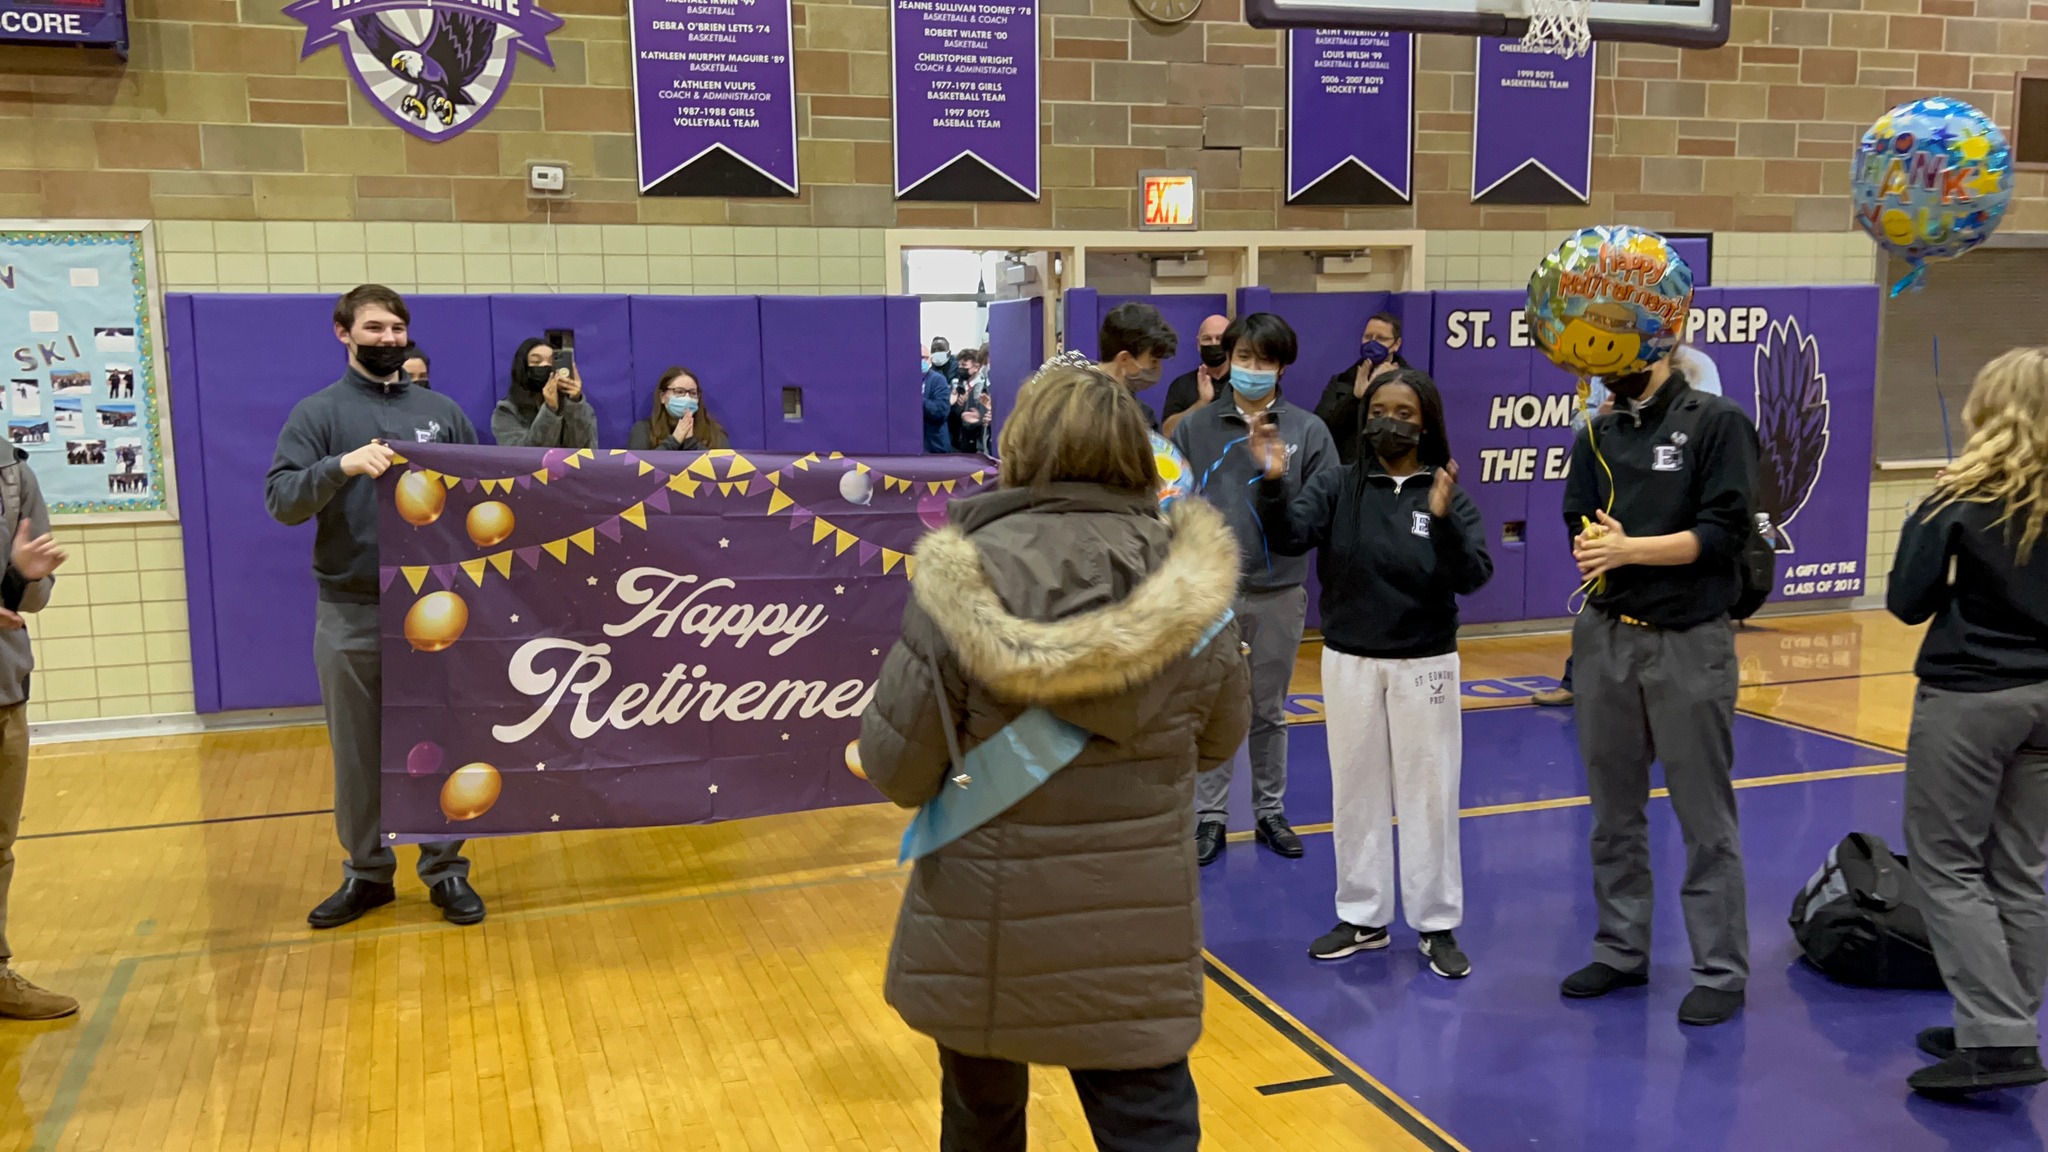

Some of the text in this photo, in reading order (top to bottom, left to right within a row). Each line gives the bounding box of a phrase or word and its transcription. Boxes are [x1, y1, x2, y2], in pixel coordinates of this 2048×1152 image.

[687, 6, 736, 16] BASKETBALL
[898, 0, 933, 10] JEANNE
[935, 2, 976, 12] SULLIVAN
[979, 4, 1015, 14] TOOMEY
[0, 11, 82, 34] CORE
[923, 13, 1008, 24] BASKETBALL & COACH
[652, 21, 770, 33] DEBRA O'BRIEN LETTS '74
[688, 33, 736, 42] BASKETBALL
[924, 28, 958, 38] ROBERT
[960, 30, 992, 40] WIATRE
[944, 40, 988, 49] BASKETBALL
[640, 51, 686, 60] KATHLEEN
[688, 52, 726, 62] MURPHY
[728, 54, 769, 63] MAGUIRE
[918, 52, 1013, 64] CHRISTOPHER WRIGHT
[1346, 52, 1370, 60] WELSH
[690, 63, 738, 72] BASKETBALL
[914, 63, 944, 72] COACH
[954, 66, 1017, 75] ADMINISTRATOR
[1314, 60, 1352, 68] BASKETBALL
[674, 80, 756, 90] KATHLEEN VULPIS
[932, 80, 1002, 91] 1977-1978 GIRLS
[1326, 86, 1378, 94] HOCKEY TEAM
[1549, 80, 1569, 88] TEAM
[658, 90, 771, 101] COACH & ADMINISTRATOR
[927, 92, 1006, 102] BASKETBALL TEAM
[678, 107, 755, 117] 1987-1988 GIRLS
[944, 108, 990, 118] 1997 BOYS
[674, 118, 760, 128] VOLLEYBALL TEAM
[933, 118, 1000, 128] BASEBALL TEAM
[1598, 241, 1668, 287] Happy
[1446, 310, 1496, 348] ST.
[1686, 307, 1768, 343] PREP
[14, 335, 81, 372] SKI
[1489, 394, 1580, 429] HOM
[1652, 444, 1683, 471] E
[1480, 448, 1538, 482] THE
[1411, 511, 1431, 539] E
[1784, 561, 1857, 579] A GIFT OF THE
[1783, 578, 1860, 596] CLASS OF 2012
[602, 566, 829, 657] Happy
[491, 637, 879, 743] Retireme
